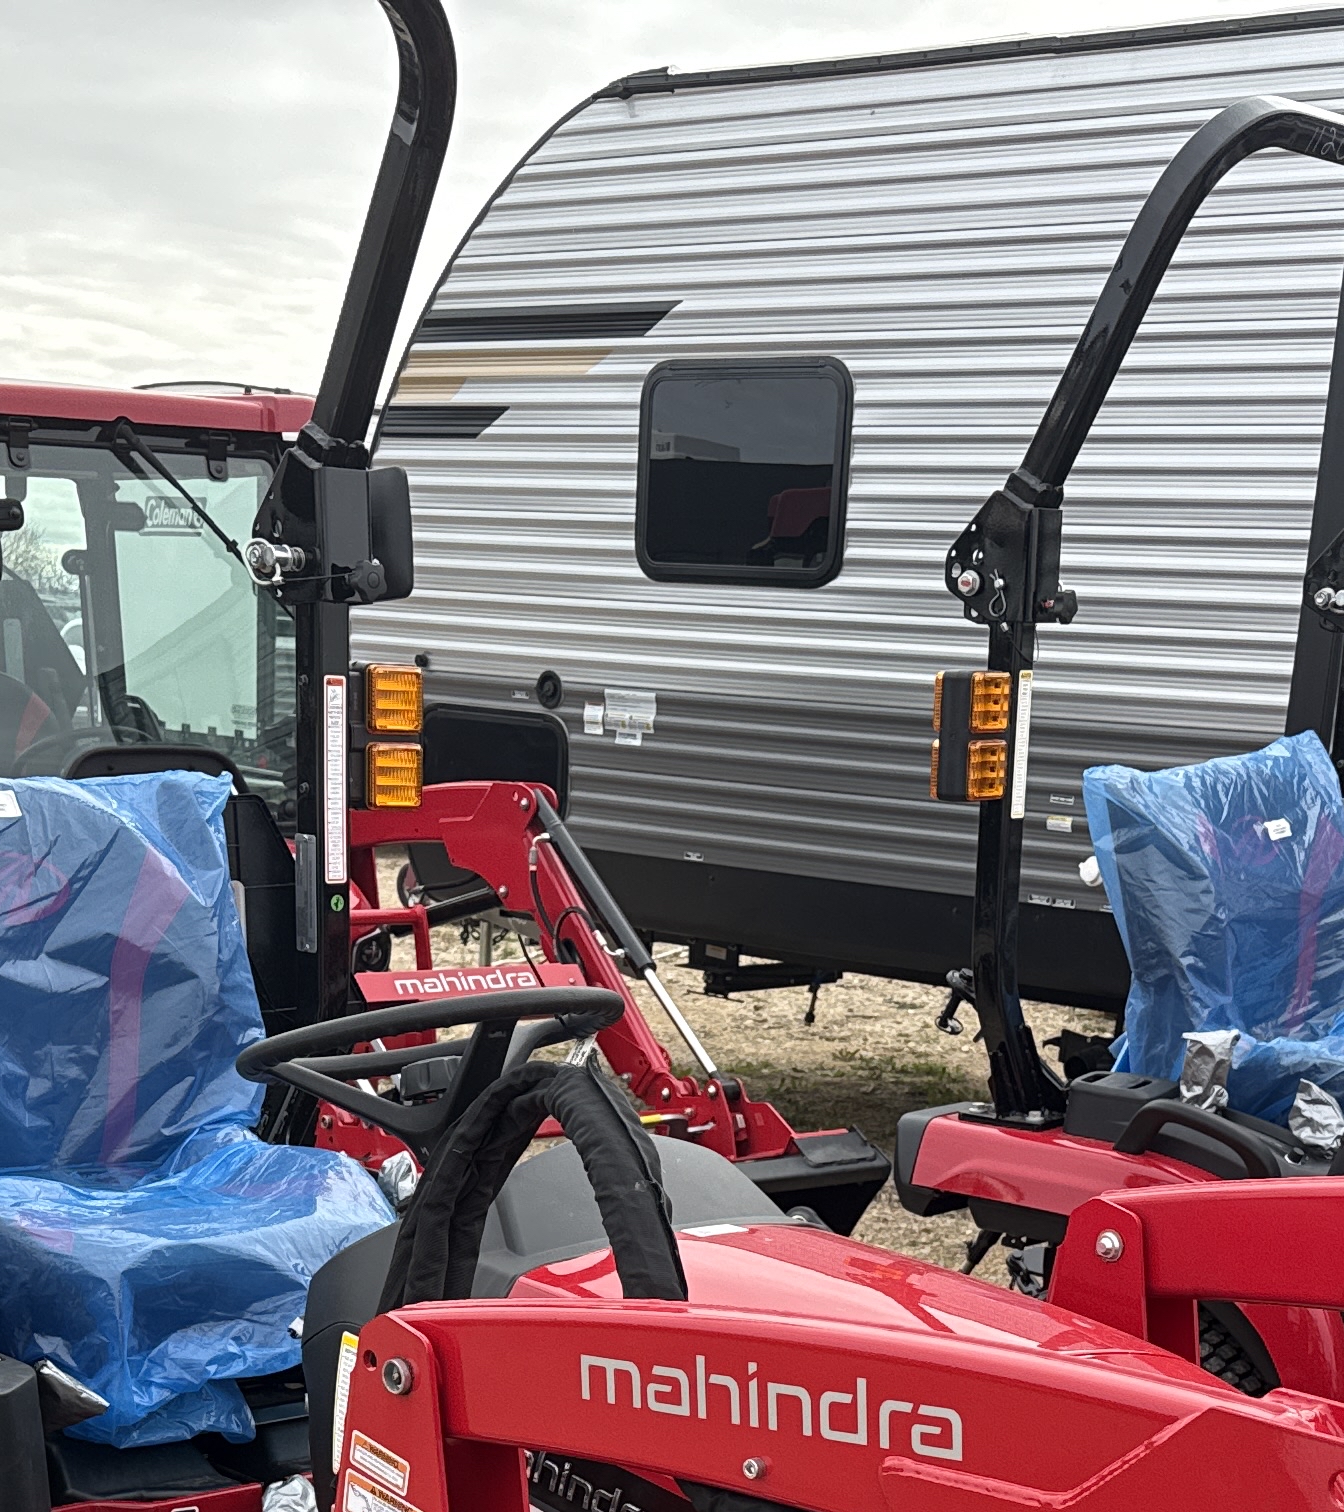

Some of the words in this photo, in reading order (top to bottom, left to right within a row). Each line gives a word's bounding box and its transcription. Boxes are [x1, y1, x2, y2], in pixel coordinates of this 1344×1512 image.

[146, 499, 193, 527] Coleman
[394, 969, 537, 995] mahindra
[580, 1354, 963, 1462] mahindra
